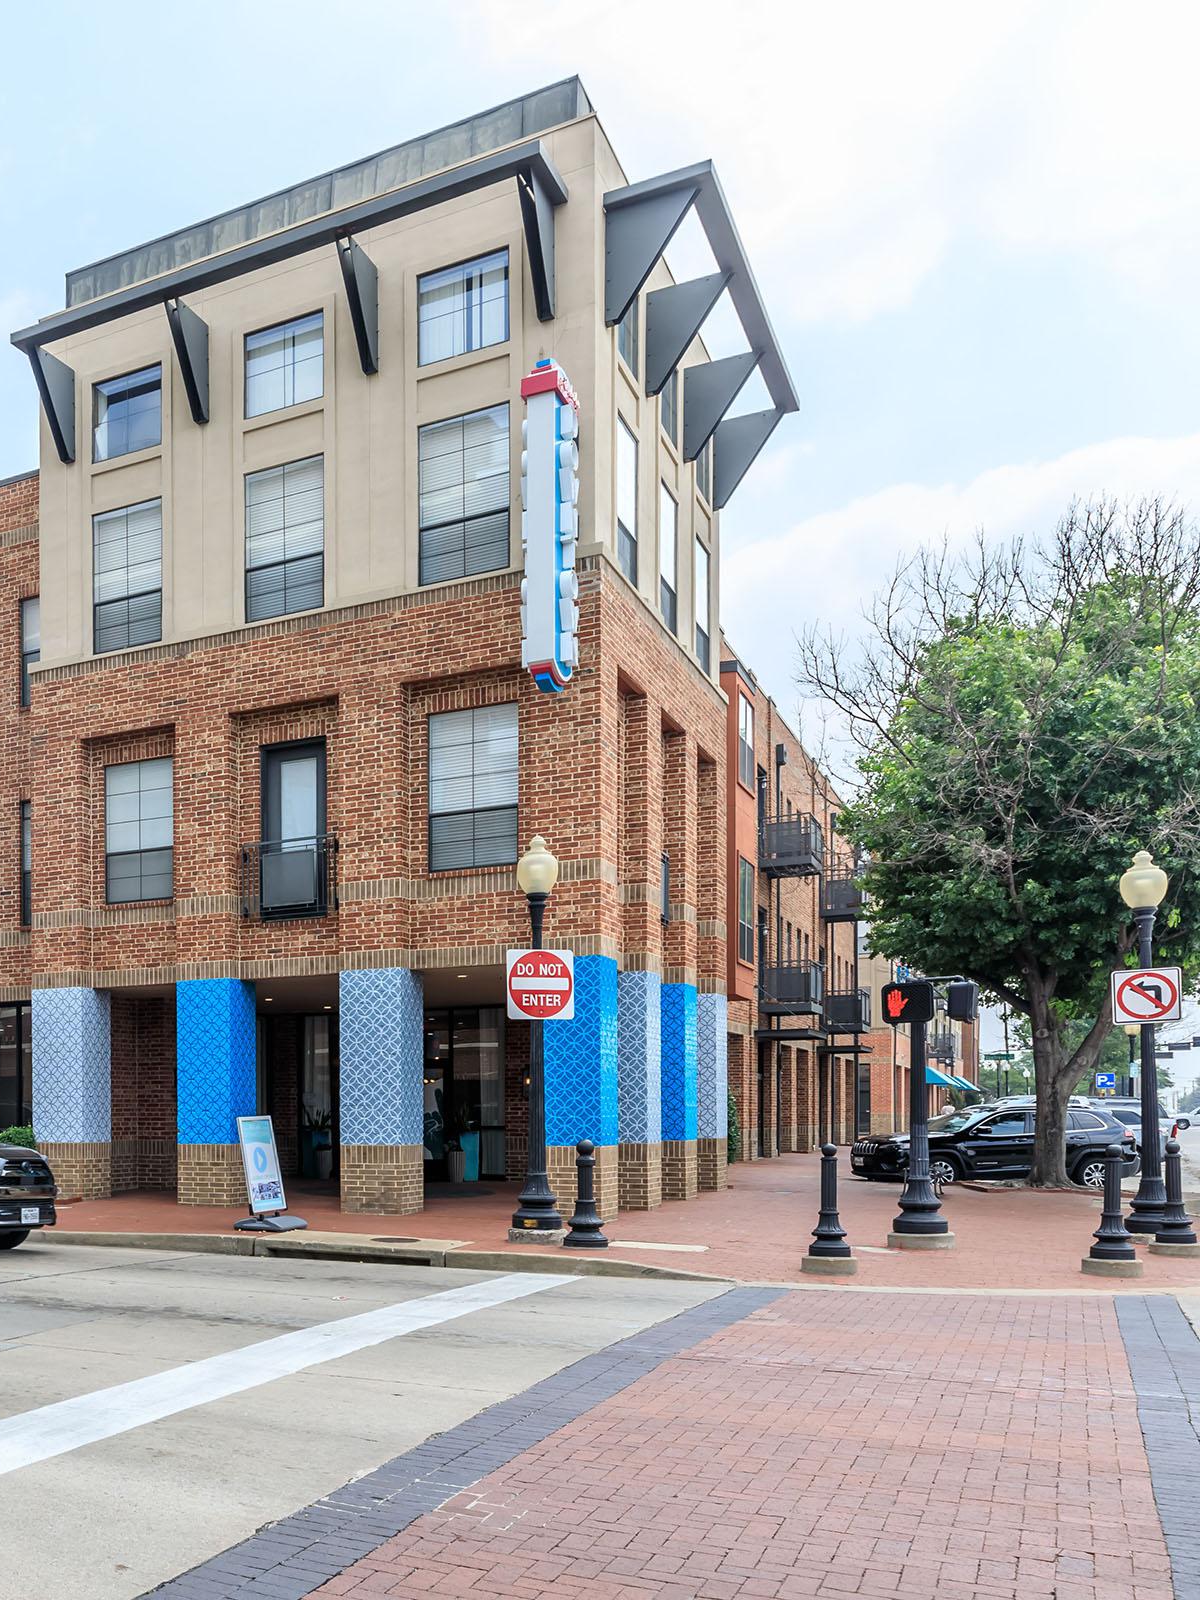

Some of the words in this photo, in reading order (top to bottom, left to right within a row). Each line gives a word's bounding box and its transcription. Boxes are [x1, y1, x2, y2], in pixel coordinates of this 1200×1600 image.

[517, 963, 534, 976] DO
[539, 963, 564, 976] NOT
[522, 993, 561, 1007] ENTER
[1097, 1075, 1108, 1086] P
